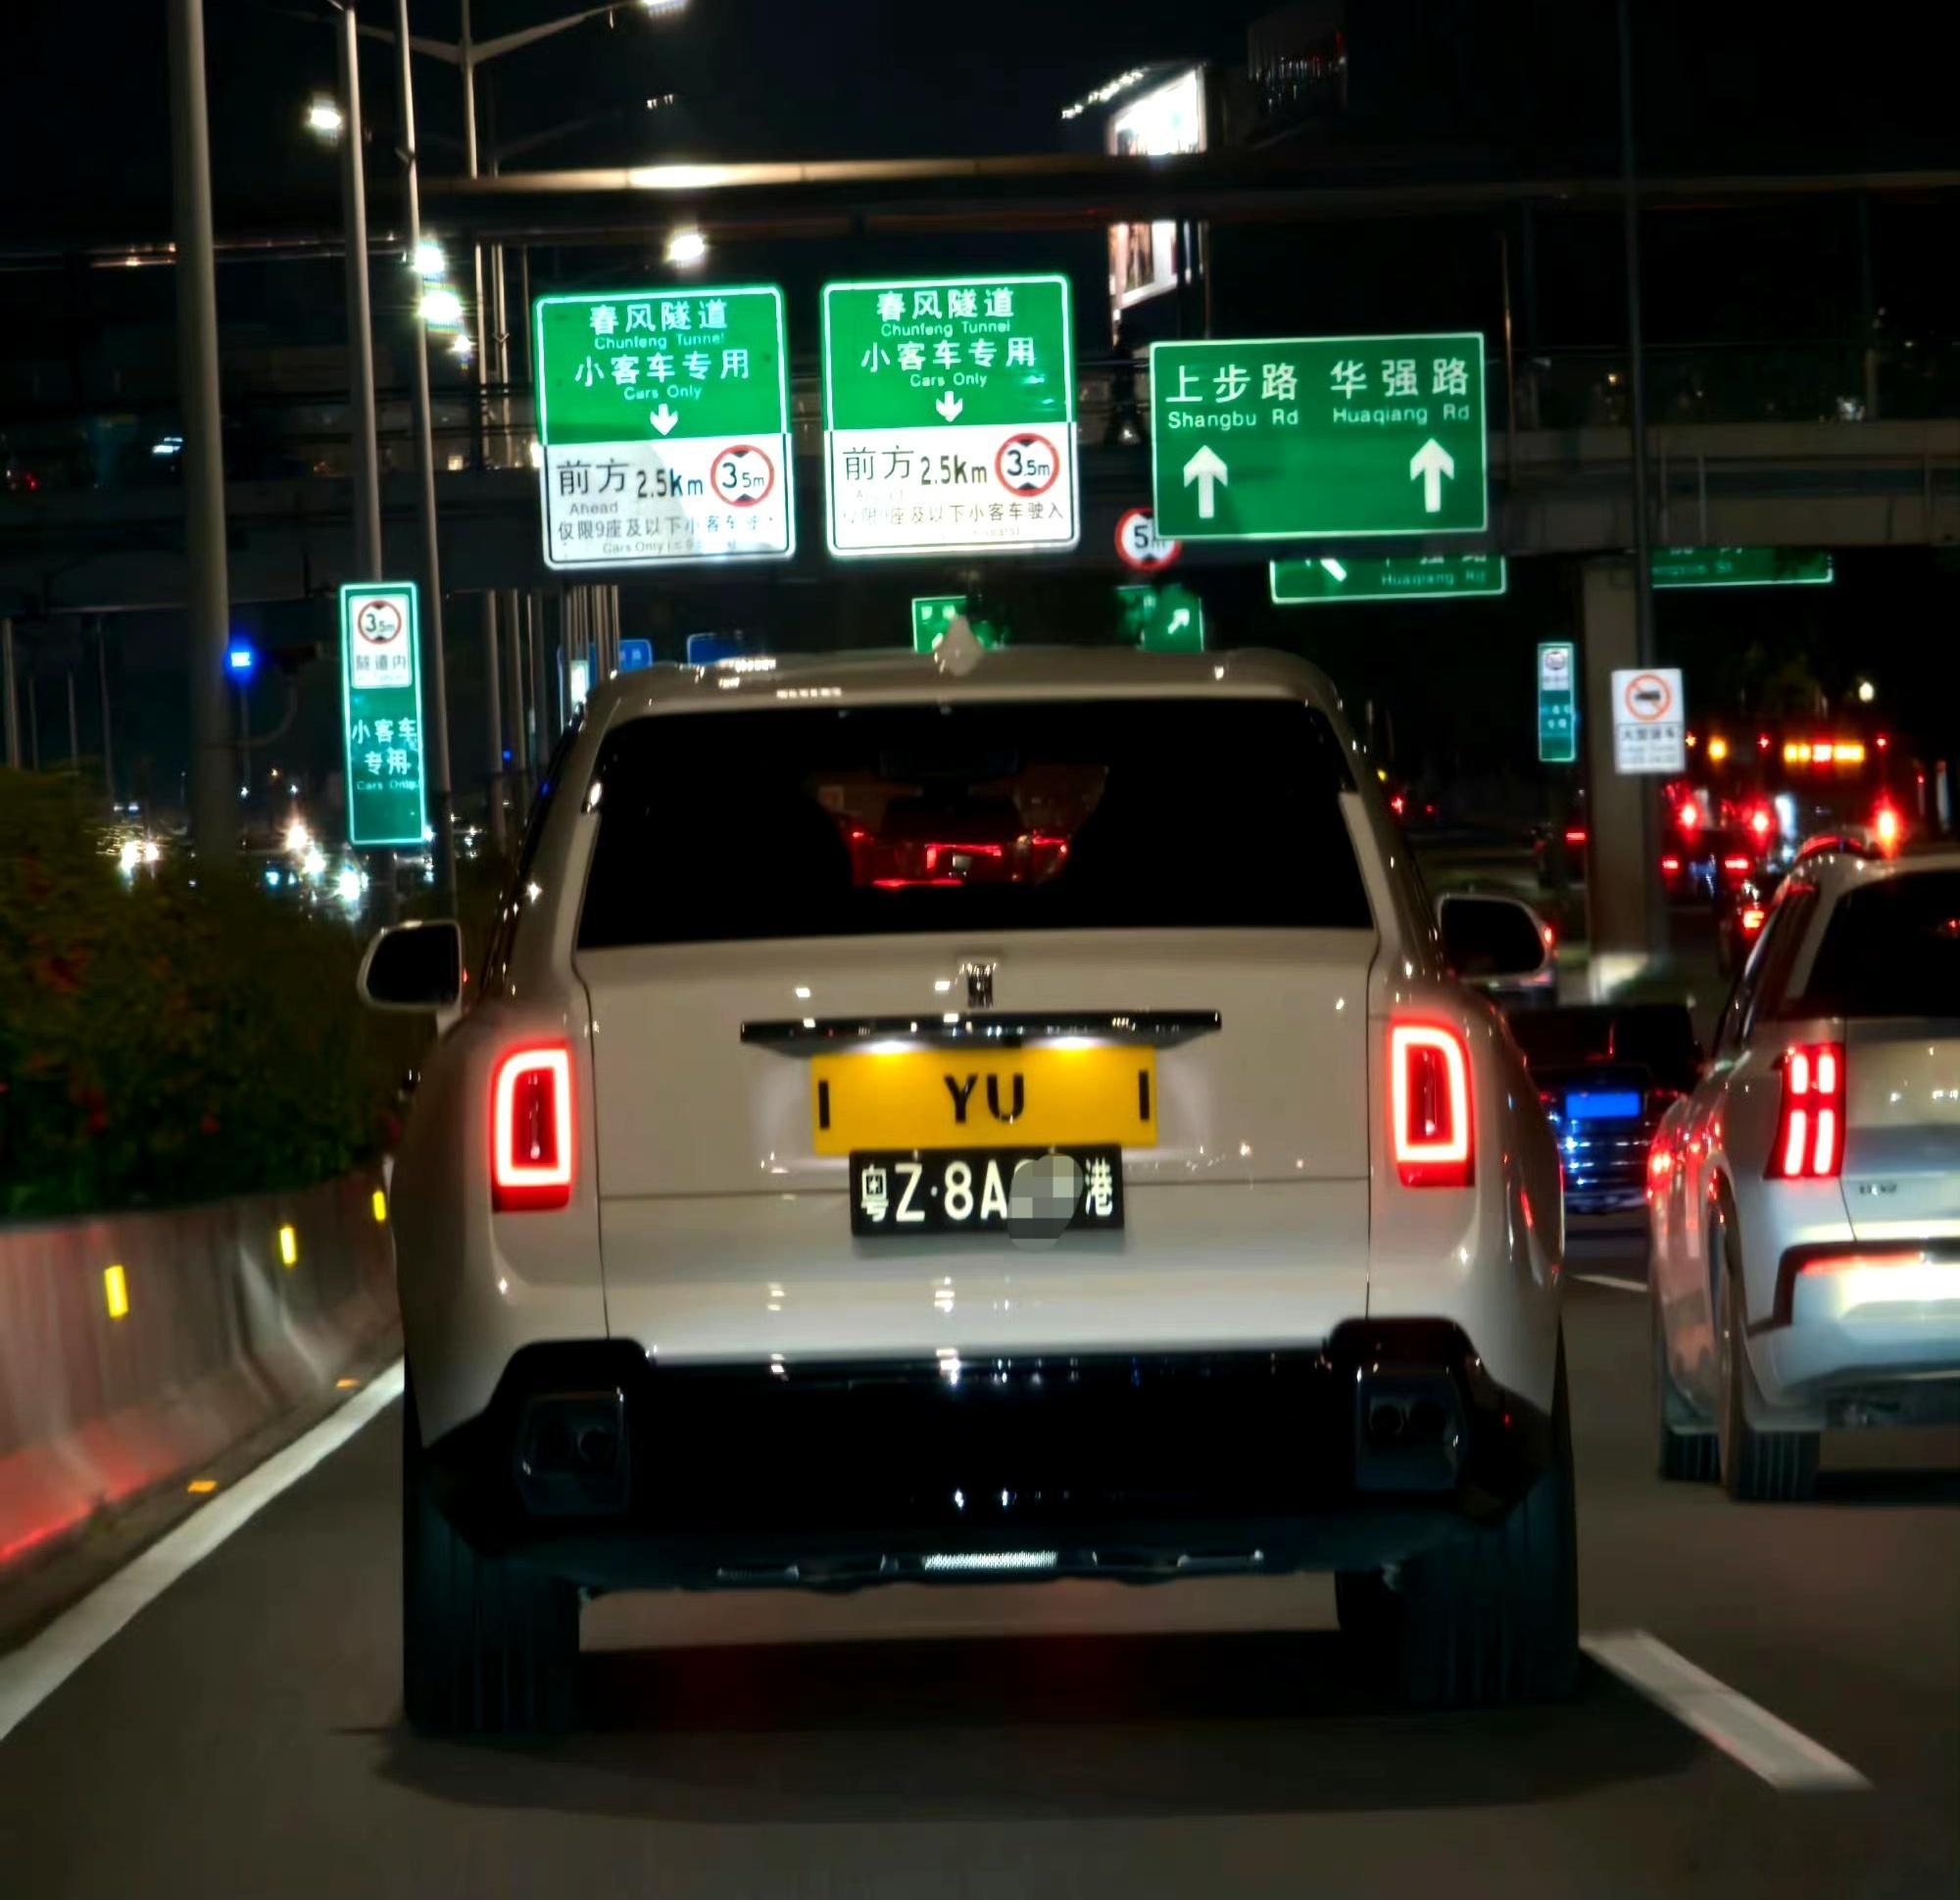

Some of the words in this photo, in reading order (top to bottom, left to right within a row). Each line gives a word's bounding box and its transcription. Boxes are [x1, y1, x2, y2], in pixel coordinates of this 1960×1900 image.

[590, 298, 727, 335] 春风隧道
[877, 287, 1014, 321] 春风隧道
[676, 332, 724, 345] Tunnel
[881, 321, 953, 337] Chunfeng
[961, 319, 1010, 333] Tunnel
[574, 349, 749, 386] 小客车专用
[860, 336, 1035, 372] 小客车专用
[623, 387, 659, 400] Cars
[666, 384, 702, 399] Only
[909, 374, 946, 387] Cars
[953, 372, 987, 388] Only
[1166, 363, 1298, 403] 上步路
[1330, 358, 1468, 400] 华强路
[1167, 412, 1256, 431] Shangbu
[1273, 410, 1298, 425] Rd
[1333, 406, 1428, 425] Huaqiang
[1444, 404, 1470, 420] Rd
[557, 458, 629, 495] 前方
[637, 468, 704, 498] 2.5km
[721, 462, 765, 489] 35m
[843, 445, 914, 480] 前方
[920, 455, 988, 485] 2.5km
[569, 502, 618, 515] Ahead
[353, 716, 416, 744] 小客车
[365, 749, 408, 775] 专用
[944, 1073, 1024, 1124] YU
